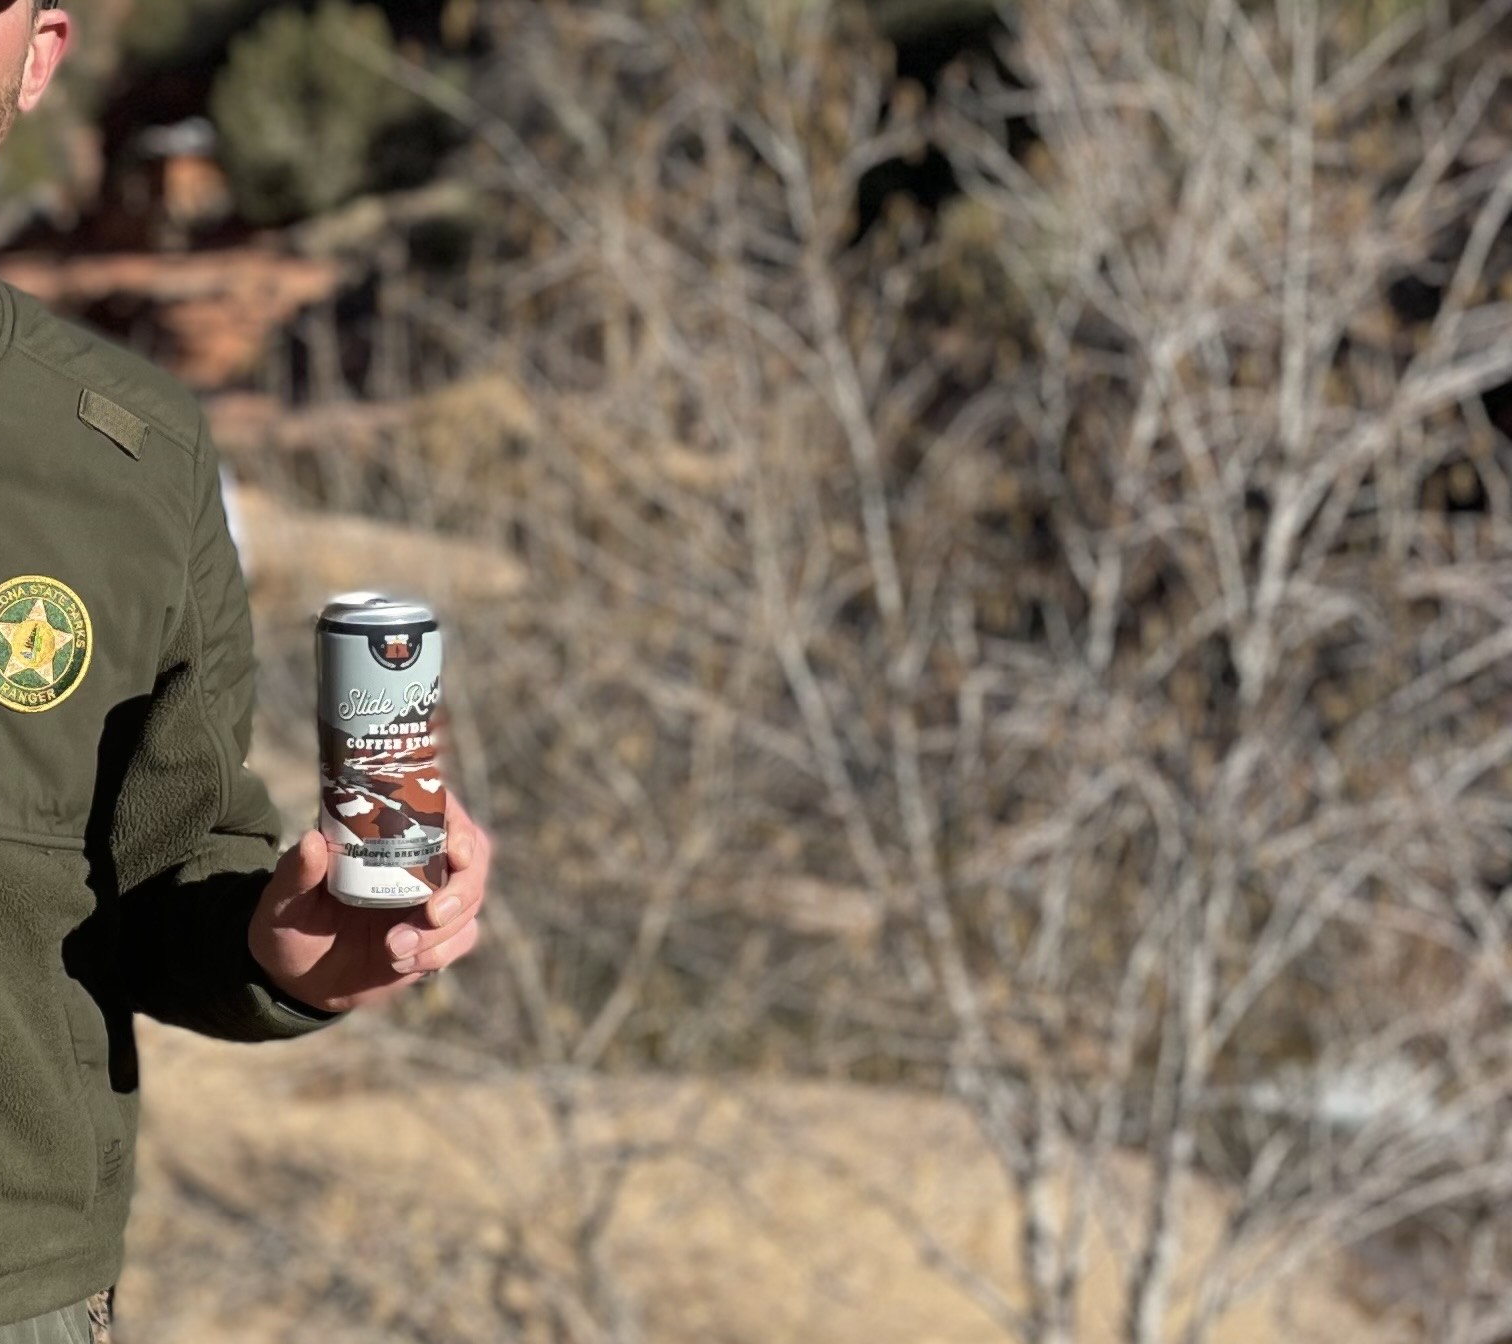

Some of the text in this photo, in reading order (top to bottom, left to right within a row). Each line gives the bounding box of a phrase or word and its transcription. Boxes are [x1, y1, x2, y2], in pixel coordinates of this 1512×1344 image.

[29, 584, 67, 606] STATE
[65, 603, 87, 649] PARKS
[0, 682, 57, 705] RANGER
[338, 680, 441, 721] Slide Roc
[368, 721, 427, 735] BLONDE
[346, 737, 403, 750] COFFEE
[344, 842, 391, 859] Historic
[370, 884, 421, 894] SLIDE ROCK
